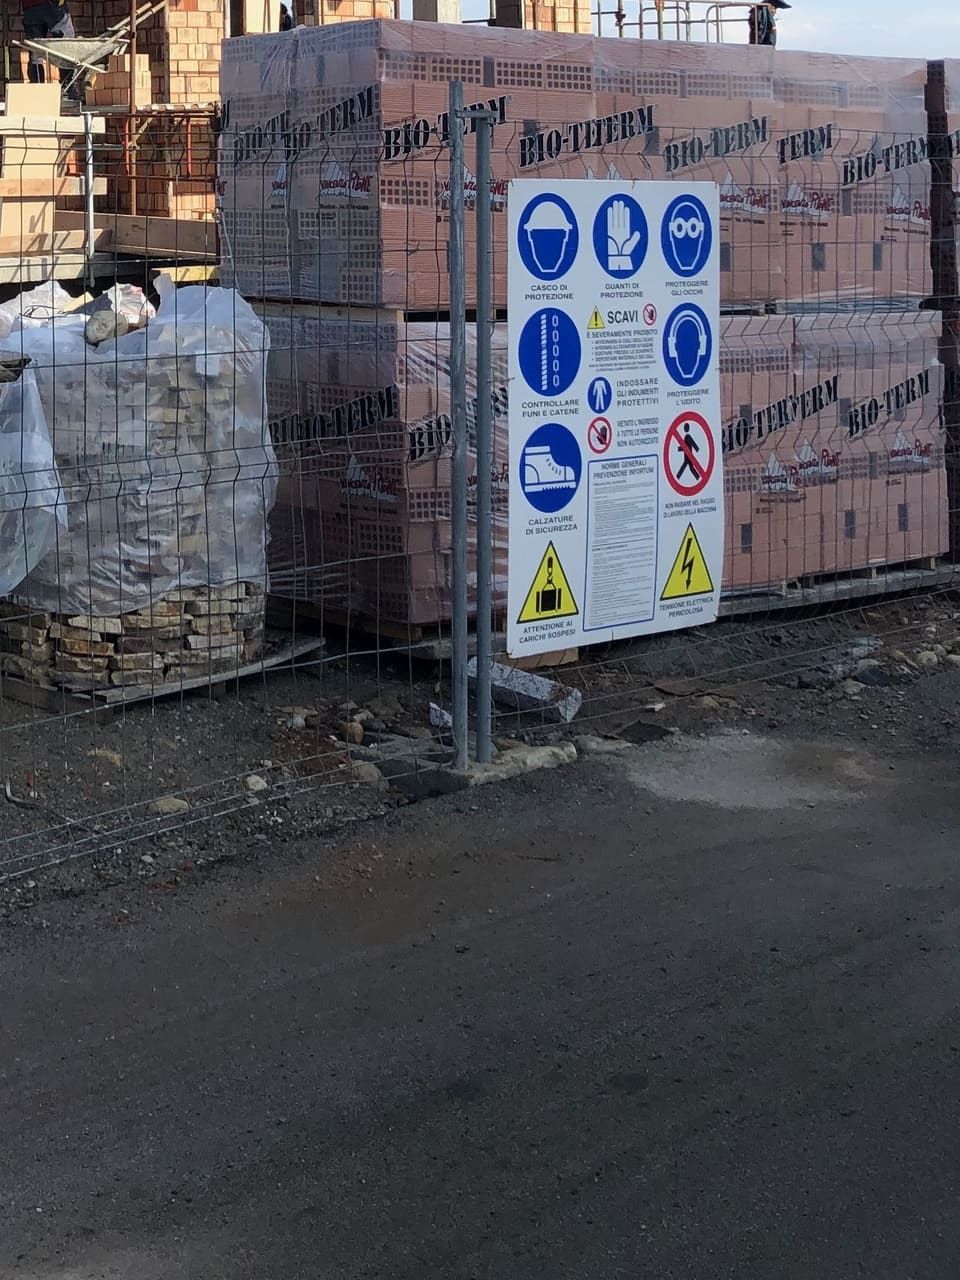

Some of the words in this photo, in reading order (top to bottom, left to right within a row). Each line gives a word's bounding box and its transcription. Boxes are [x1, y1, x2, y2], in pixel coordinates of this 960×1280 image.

[384, 96, 506, 160] BIO-TRM
[665, 116, 768, 172] BIO-TERM
[776, 124, 833, 165] TERM
[530, 284, 558, 292] CASCO
[665, 280, 709, 288] PROTEGGERE
[607, 310, 639, 324] SCAVI
[592, 330, 632, 338] SEVERAMENTE
[616, 377, 659, 388] INDOSSARE
[616, 389, 627, 398] GLI
[628, 388, 659, 397] INDUMENTI
[667, 389, 709, 398] PROTEGGERE
[521, 398, 580, 409] CONTROLLARE
[616, 398, 659, 407] PROTETTIVI
[676, 398, 701, 406] L'UDITO
[848, 369, 930, 438] BIO-TERM
[522, 410, 541, 418] FUNI
[542, 409, 548, 417] E
[549, 408, 580, 417] CATENE
[528, 515, 574, 526] CALZATURE
[525, 528, 535, 536] DI
[535, 524, 578, 535] SICUREZZA
[659, 601, 685, 612] TENSIONE
[686, 597, 714, 607] ELETTRICA
[668, 607, 703, 618] PERICOLOSA
[523, 621, 565, 634] ATTENZIONE
[519, 633, 546, 644] CARICHI
[547, 629, 576, 640] SOSPESI
